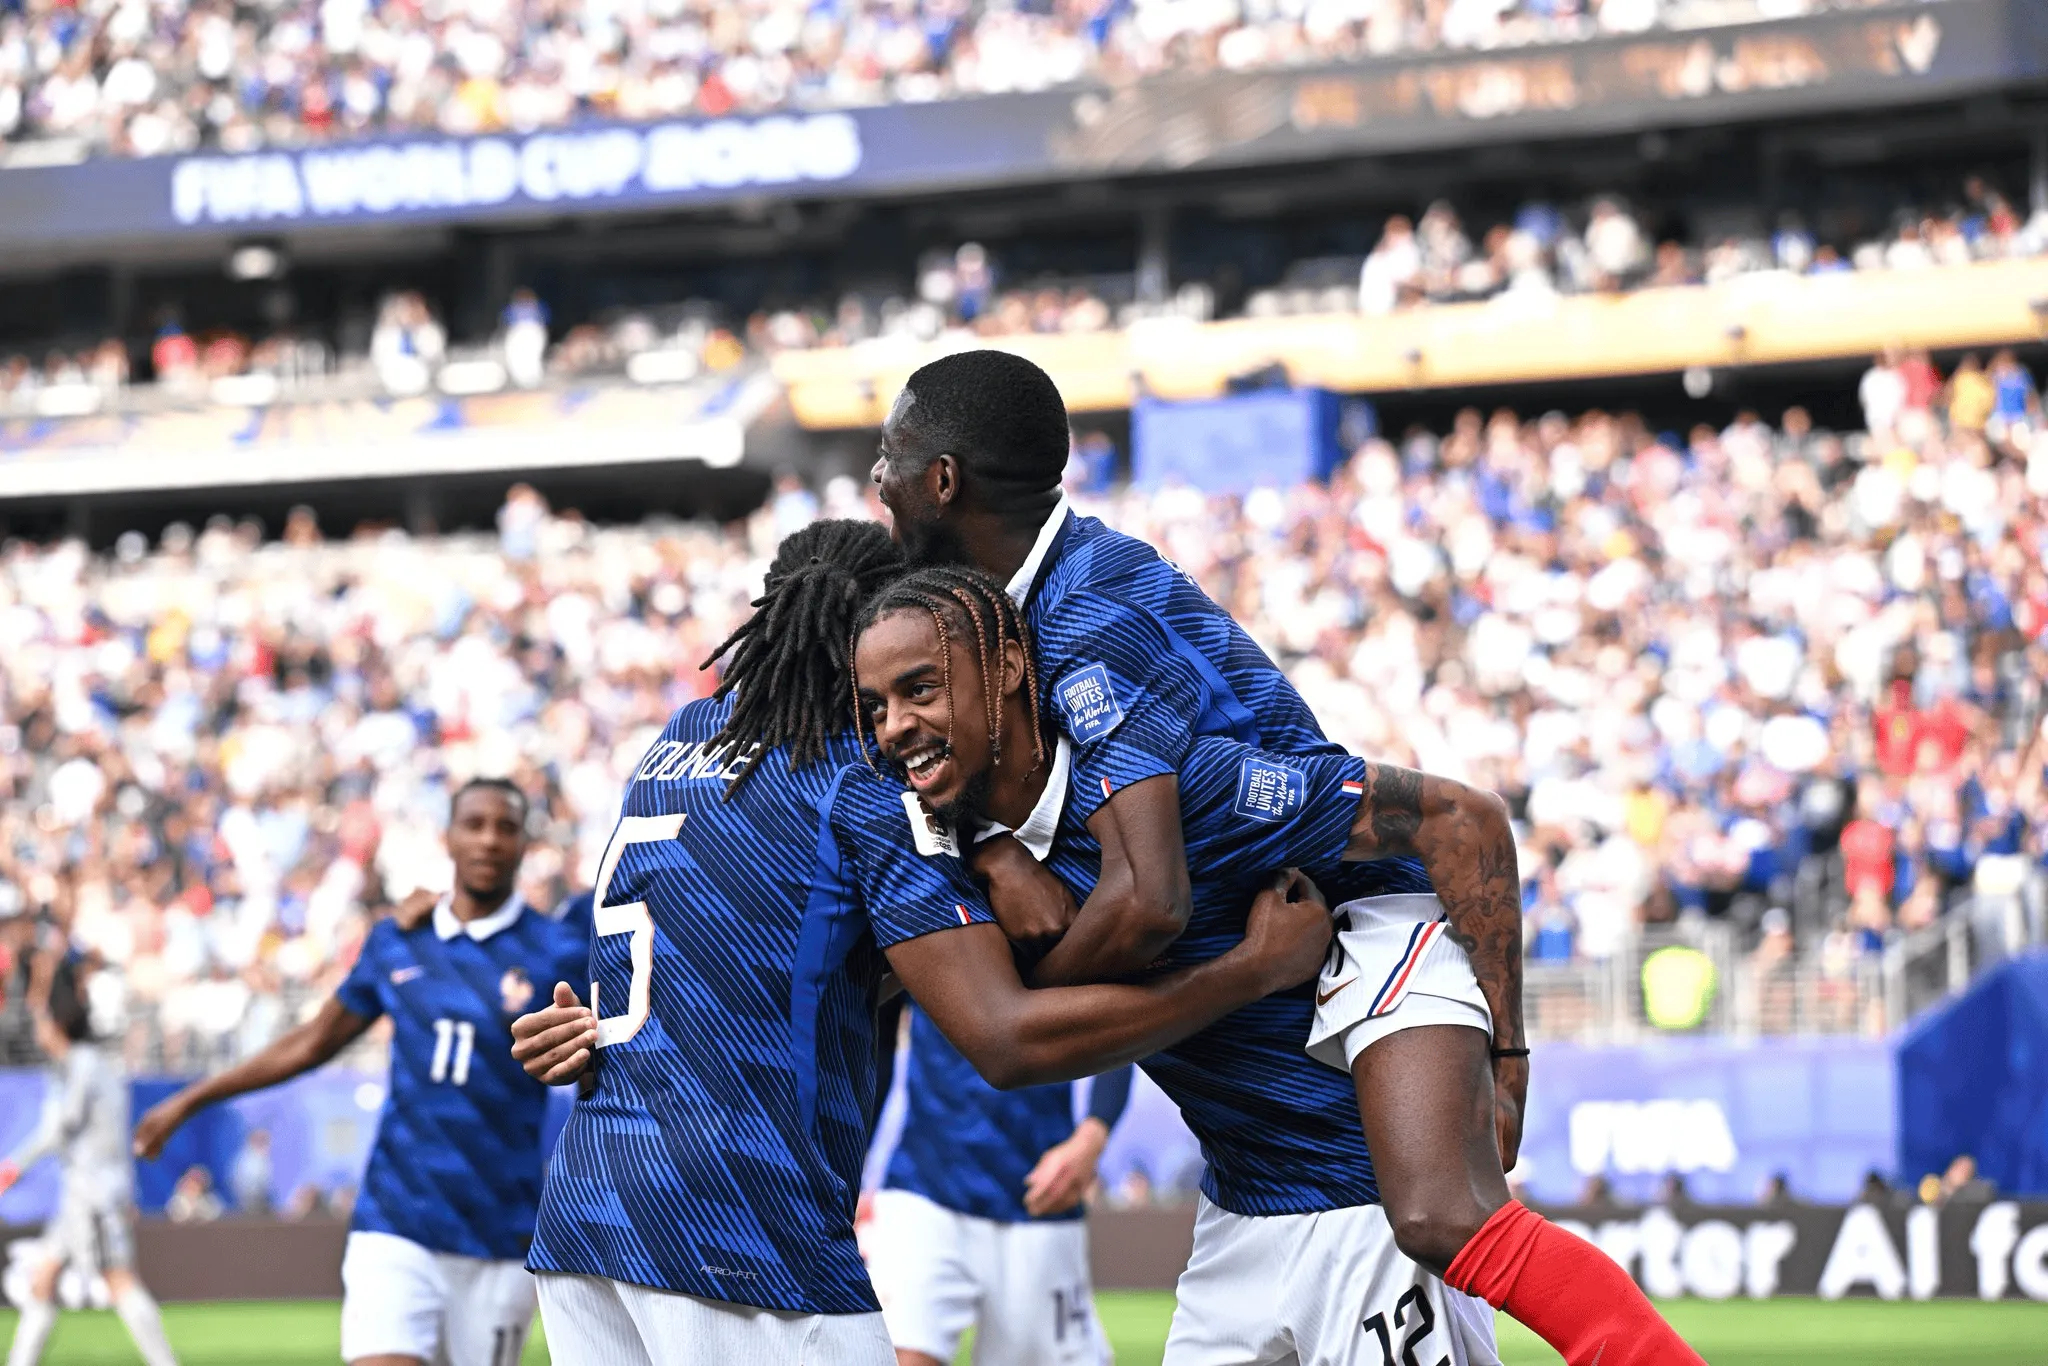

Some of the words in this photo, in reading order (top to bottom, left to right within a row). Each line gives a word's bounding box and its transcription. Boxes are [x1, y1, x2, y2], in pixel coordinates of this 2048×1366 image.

[172, 154, 302, 224] FIFA
[304, 137, 517, 217] WORLD
[520, 127, 641, 201] CUP
[645, 113, 862, 191] 2026
[1063, 676, 1100, 700] FOOTBALL
[1067, 686, 1105, 713] UNITES
[1074, 713, 1085, 728] the
[1083, 700, 1111, 721] World
[1085, 719, 1101, 731] FIFA
[1245, 768, 1262, 808] FOOTBALL
[1256, 770, 1276, 811] UNITES
[1275, 770, 1289, 800] World
[1287, 788, 1295, 806] FIFA
[1271, 800, 1284, 816] the
[590, 813, 688, 1050] 5
[429, 1017, 476, 1087] 11
[1569, 1098, 1739, 1175] FIFA
[1556, 1203, 1796, 1300] rter
[1816, 1202, 1941, 1301] AI
[700, 1265, 759, 1280] AERO-FIT
[1362, 1283, 1452, 1366] 12
